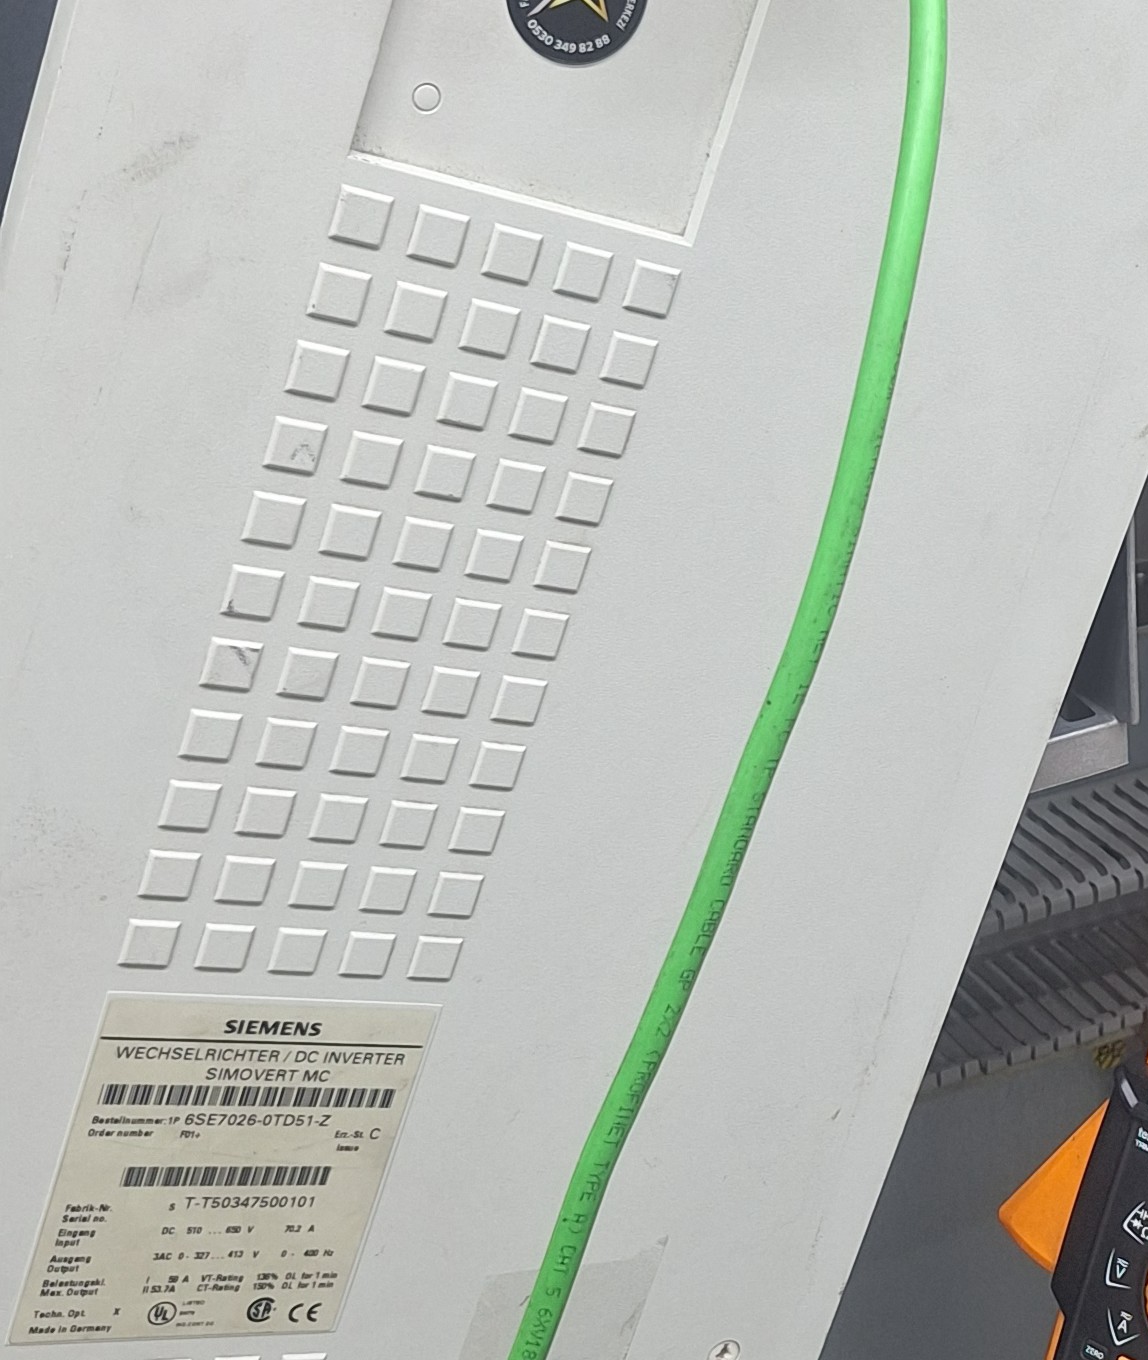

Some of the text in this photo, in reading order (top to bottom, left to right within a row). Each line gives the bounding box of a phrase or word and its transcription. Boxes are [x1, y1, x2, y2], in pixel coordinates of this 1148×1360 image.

[527, 18, 611, 54] 0530 349 82 88
[689, 898, 725, 957] CABLE
[678, 968, 696, 991] GP
[223, 1019, 323, 1037] SIEMENS
[116, 1045, 281, 1063] WECHSELRICHTER
[295, 1050, 320, 1064] DC
[323, 1051, 406, 1066] INVERTER
[205, 1067, 331, 1083] SIMOVERT MC
[184, 1113, 332, 1128] 6SE7026-0TD51-Z
[88, 1128, 115, 1138] Order
[117, 1128, 154, 1138] number
[369, 1128, 381, 1140] C
[579, 1160, 611, 1202] TYPE
[185, 1195, 316, 1210] T-T50347500101
[62, 1214, 91, 1223] Serial
[58, 1228, 96, 1239] Eingang
[161, 1226, 176, 1236] DC
[247, 1225, 255, 1234] V
[307, 1224, 315, 1233] A
[55, 1238, 80, 1248] Input
[50, 1254, 92, 1265] Ausgang
[252, 1250, 260, 1259] V
[553, 1244, 577, 1275] CAT
[47, 1264, 79, 1274] Output
[182, 1275, 190, 1283] A
[201, 1273, 244, 1284] VT-Rating
[322, 1271, 338, 1279] min
[66, 1287, 99, 1298] Output
[196, 1283, 240, 1293] CT-Rating
[318, 1281, 334, 1289] min
[546, 1287, 561, 1299] 5
[28, 1324, 112, 1335] Made in Germany
[1085, 1344, 1105, 1360] ZERO
